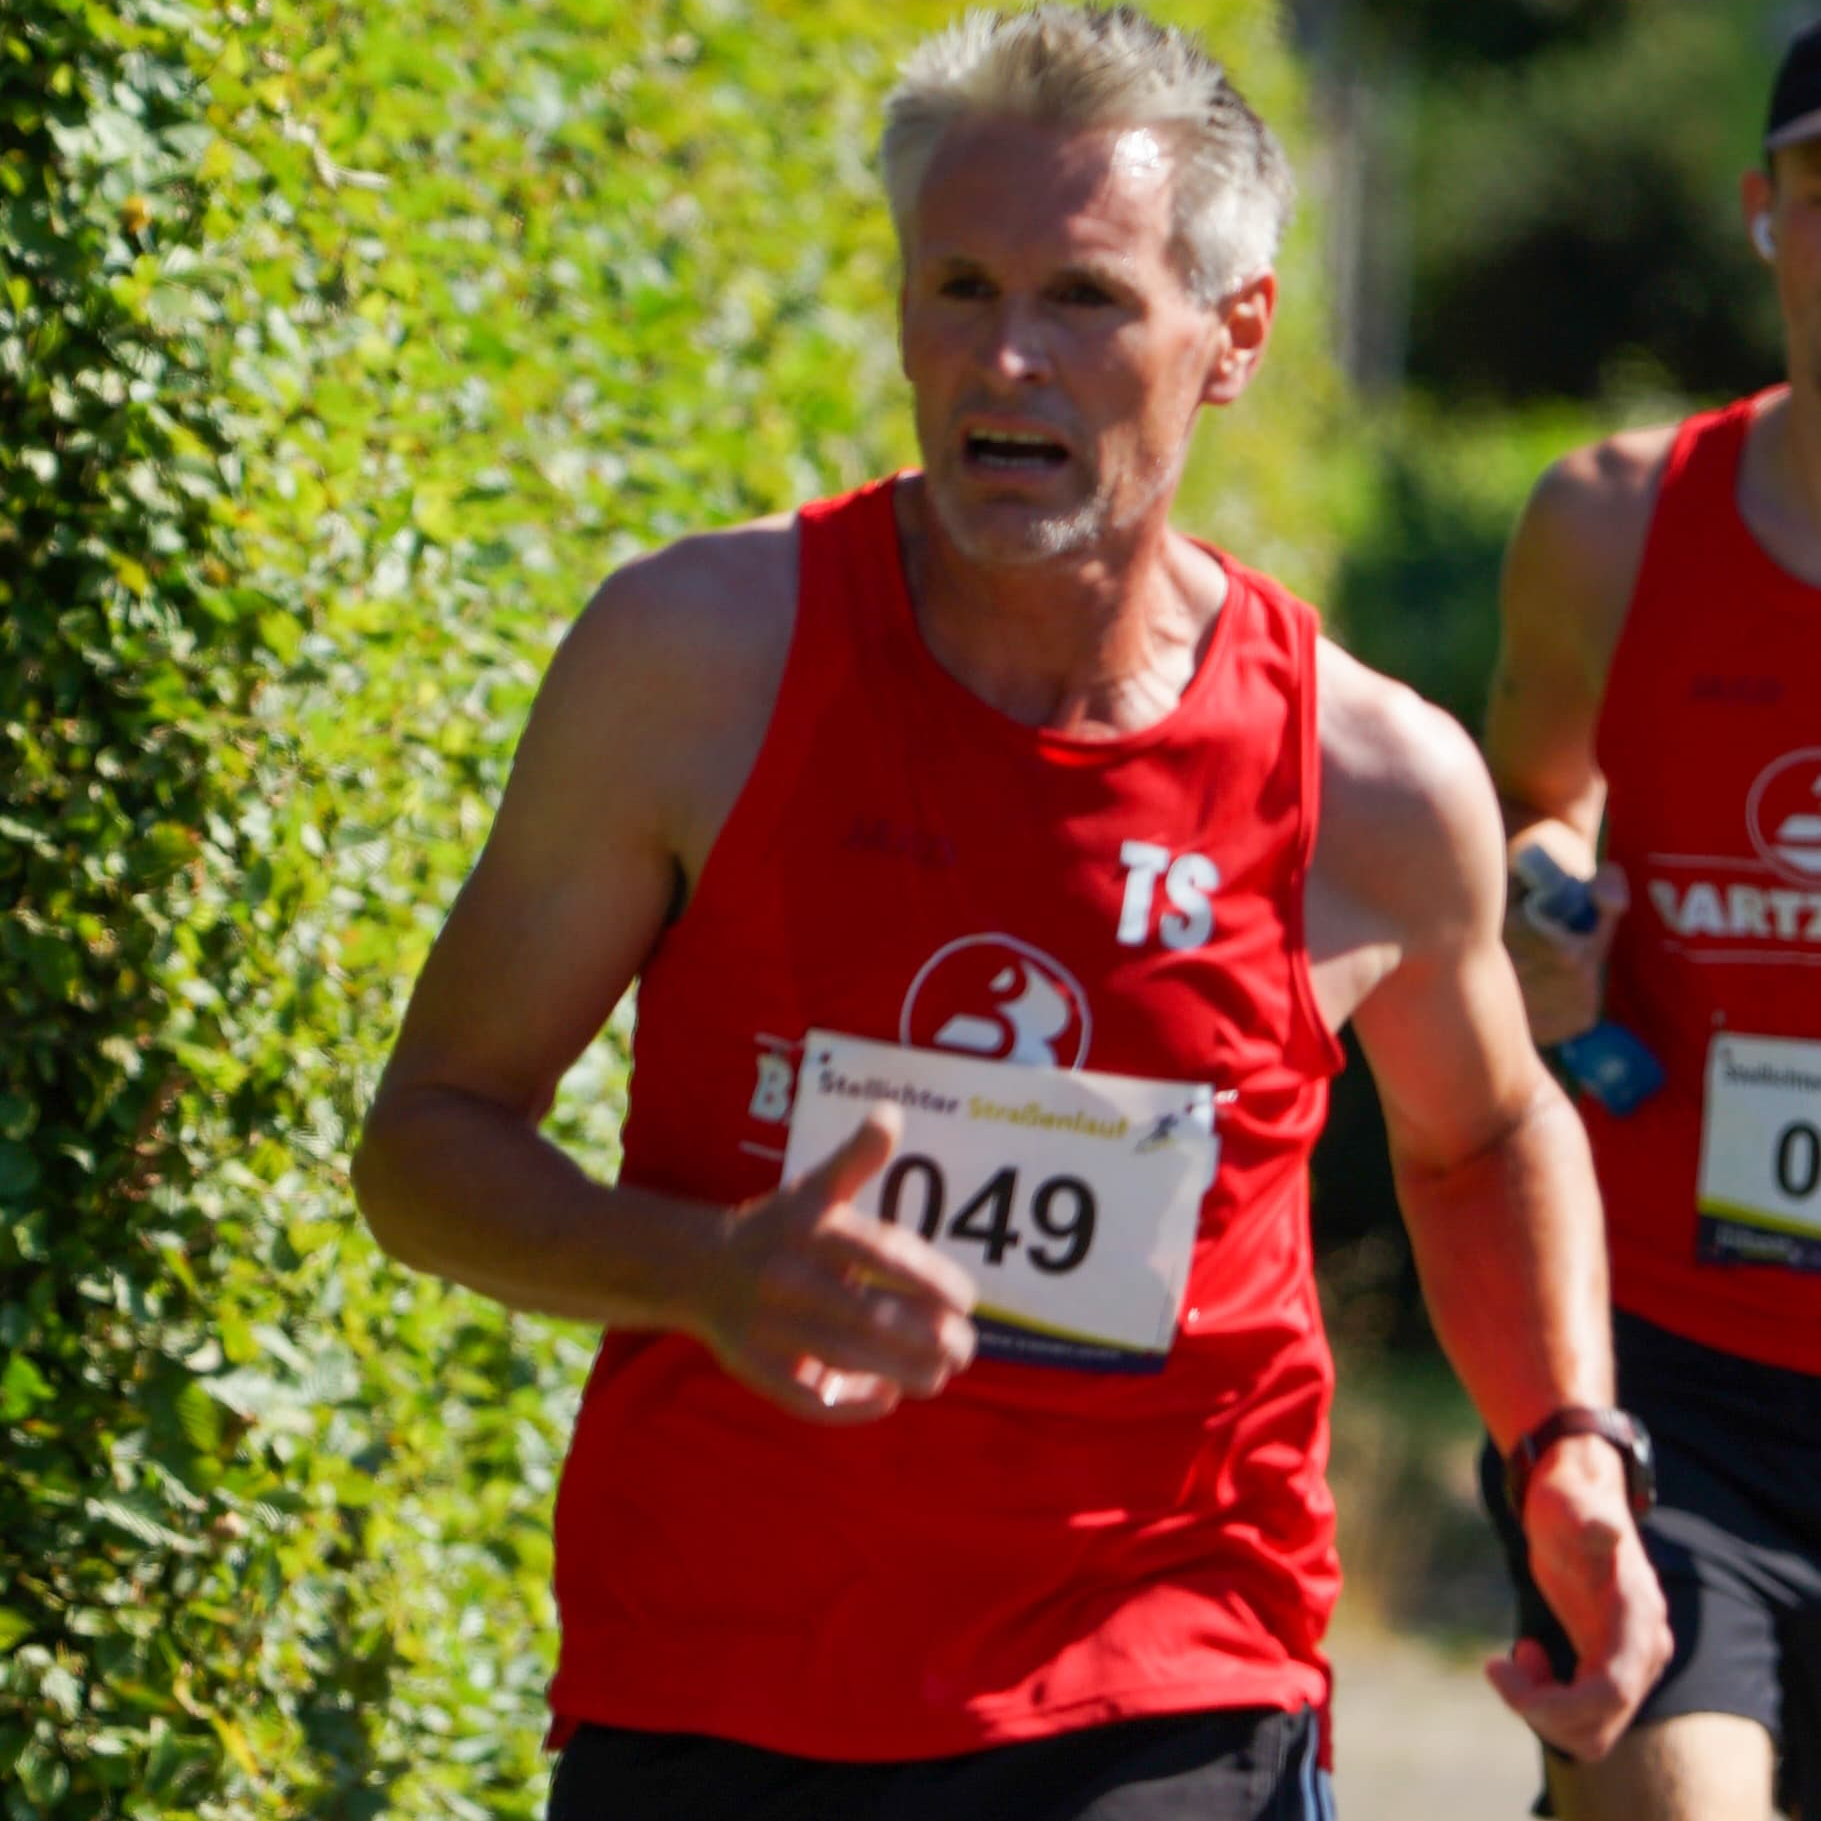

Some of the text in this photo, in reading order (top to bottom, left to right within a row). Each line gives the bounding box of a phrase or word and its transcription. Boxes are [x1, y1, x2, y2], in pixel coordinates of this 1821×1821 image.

[1116, 839, 1220, 950] TS
[967, 1091, 1129, 1139] Straßenlauf
[880, 1152, 1097, 1276] 049
